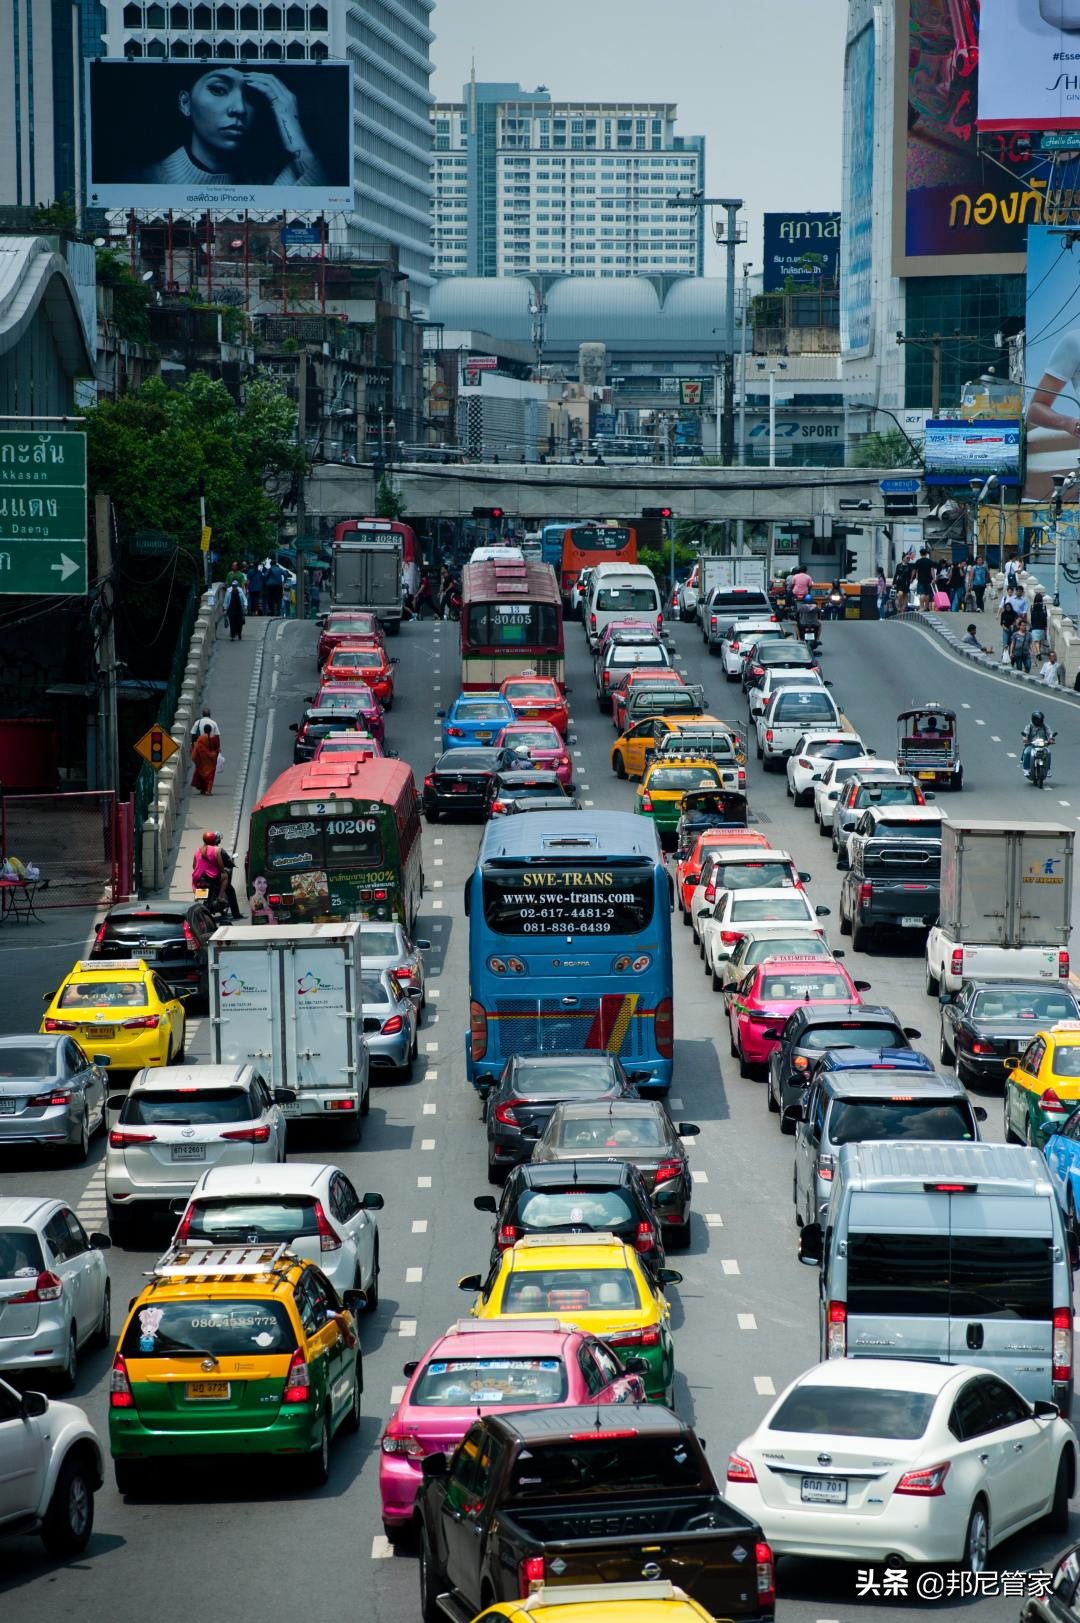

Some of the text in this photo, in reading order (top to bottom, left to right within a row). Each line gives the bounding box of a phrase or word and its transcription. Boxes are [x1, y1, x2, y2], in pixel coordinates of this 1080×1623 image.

[1046, 74, 1080, 90] SH
[220, 193, 249, 202] iPhone
[249, 193, 256, 202] X
[801, 425, 839, 437] SPORT
[12, 524, 49, 536] Daeng
[316, 803, 326, 814] 2
[326, 819, 377, 835] 40206
[366, 870, 394, 883] 100%
[523, 872, 613, 887] SWE-TRANS
[503, 891, 635, 904] www.swe-trans.com
[520, 908, 615, 918] 02-617-4481-2
[523, 923, 611, 933] 081-836-6439
[207, 1382, 227, 1392] 3725
[826, 1481, 842, 1492] 701
[562, 1515, 656, 1534] NISSAN
